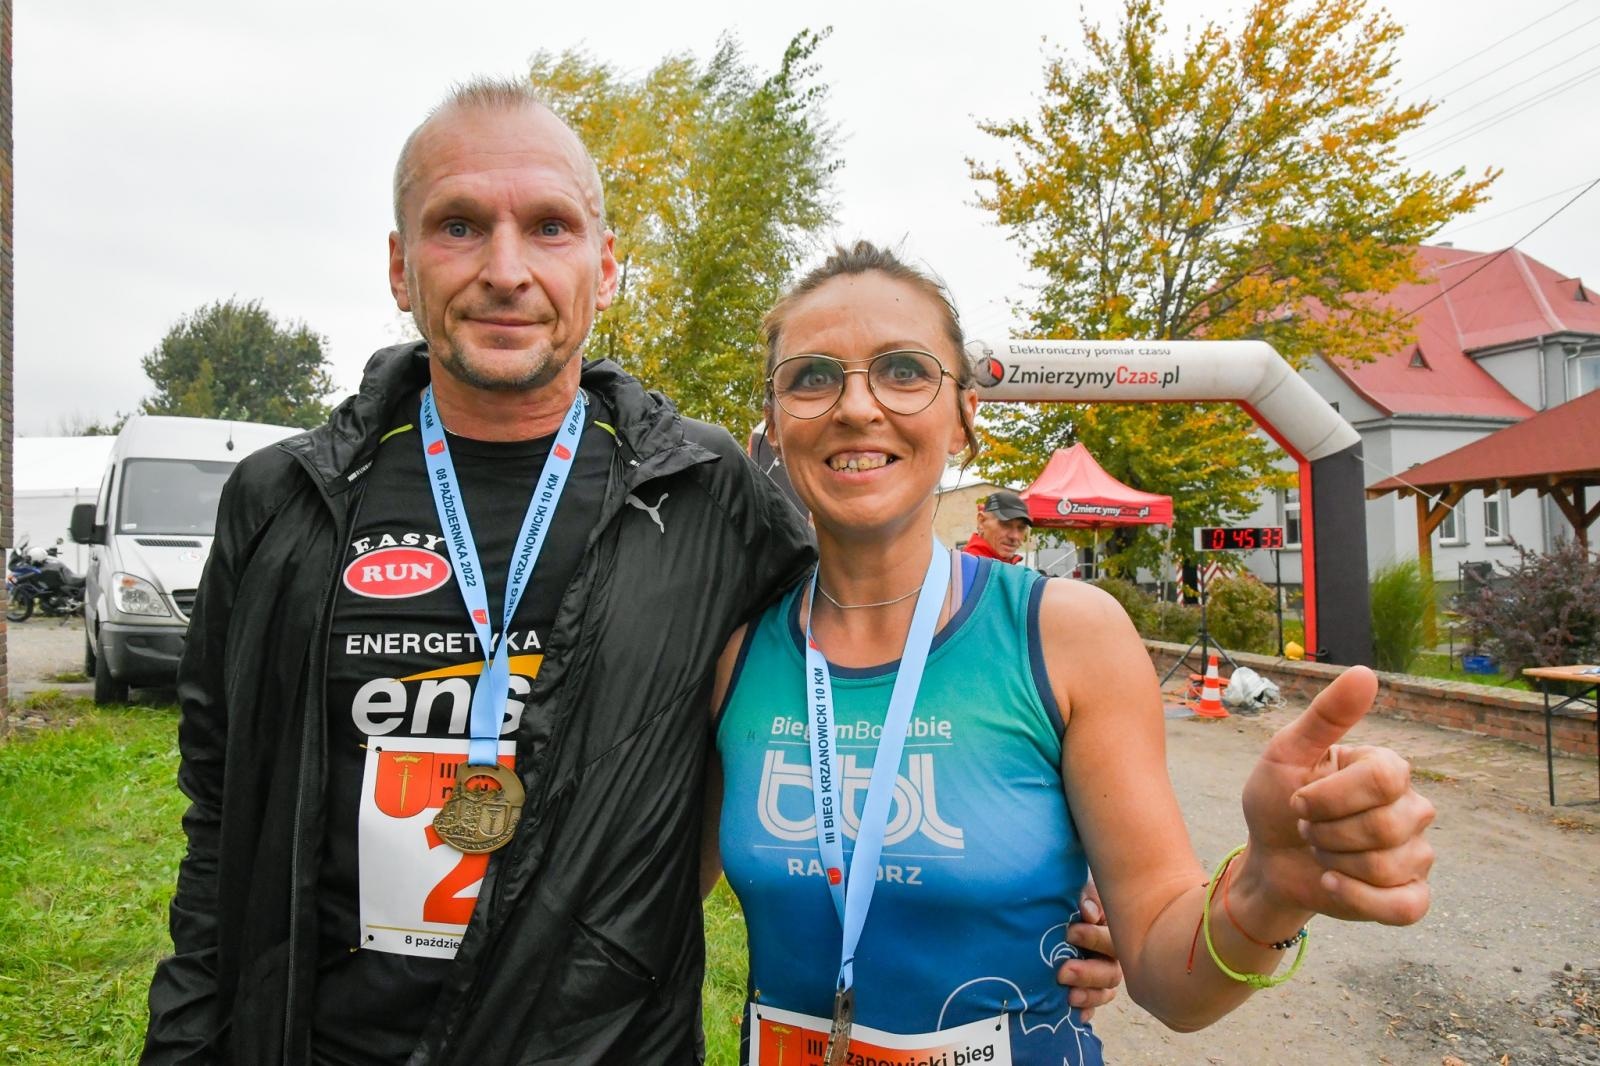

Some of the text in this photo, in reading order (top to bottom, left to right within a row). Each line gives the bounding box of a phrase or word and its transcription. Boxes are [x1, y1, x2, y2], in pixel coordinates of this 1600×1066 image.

[1009, 345, 1091, 358] Elektroniczny
[1095, 346, 1135, 357] pomiar
[1008, 365, 1180, 388] ZmierzymyCzas.pl
[435, 468, 447, 480] 08
[461, 561, 476, 588] 2022
[1233, 529, 1255, 549] 45
[1262, 528, 1282, 548] 33
[352, 533, 445, 555] EASY
[505, 473, 560, 618] BIEG KRZANOWICKI 10 KM
[361, 562, 434, 582] RUN
[345, 630, 541, 654] ENERGETYKA
[814, 667, 836, 844] III BIEG KRZANOWICKI 10 KM
[405, 934, 413, 945] 8
[807, 1038, 823, 1056] III
[953, 1044, 995, 1066] bieg
